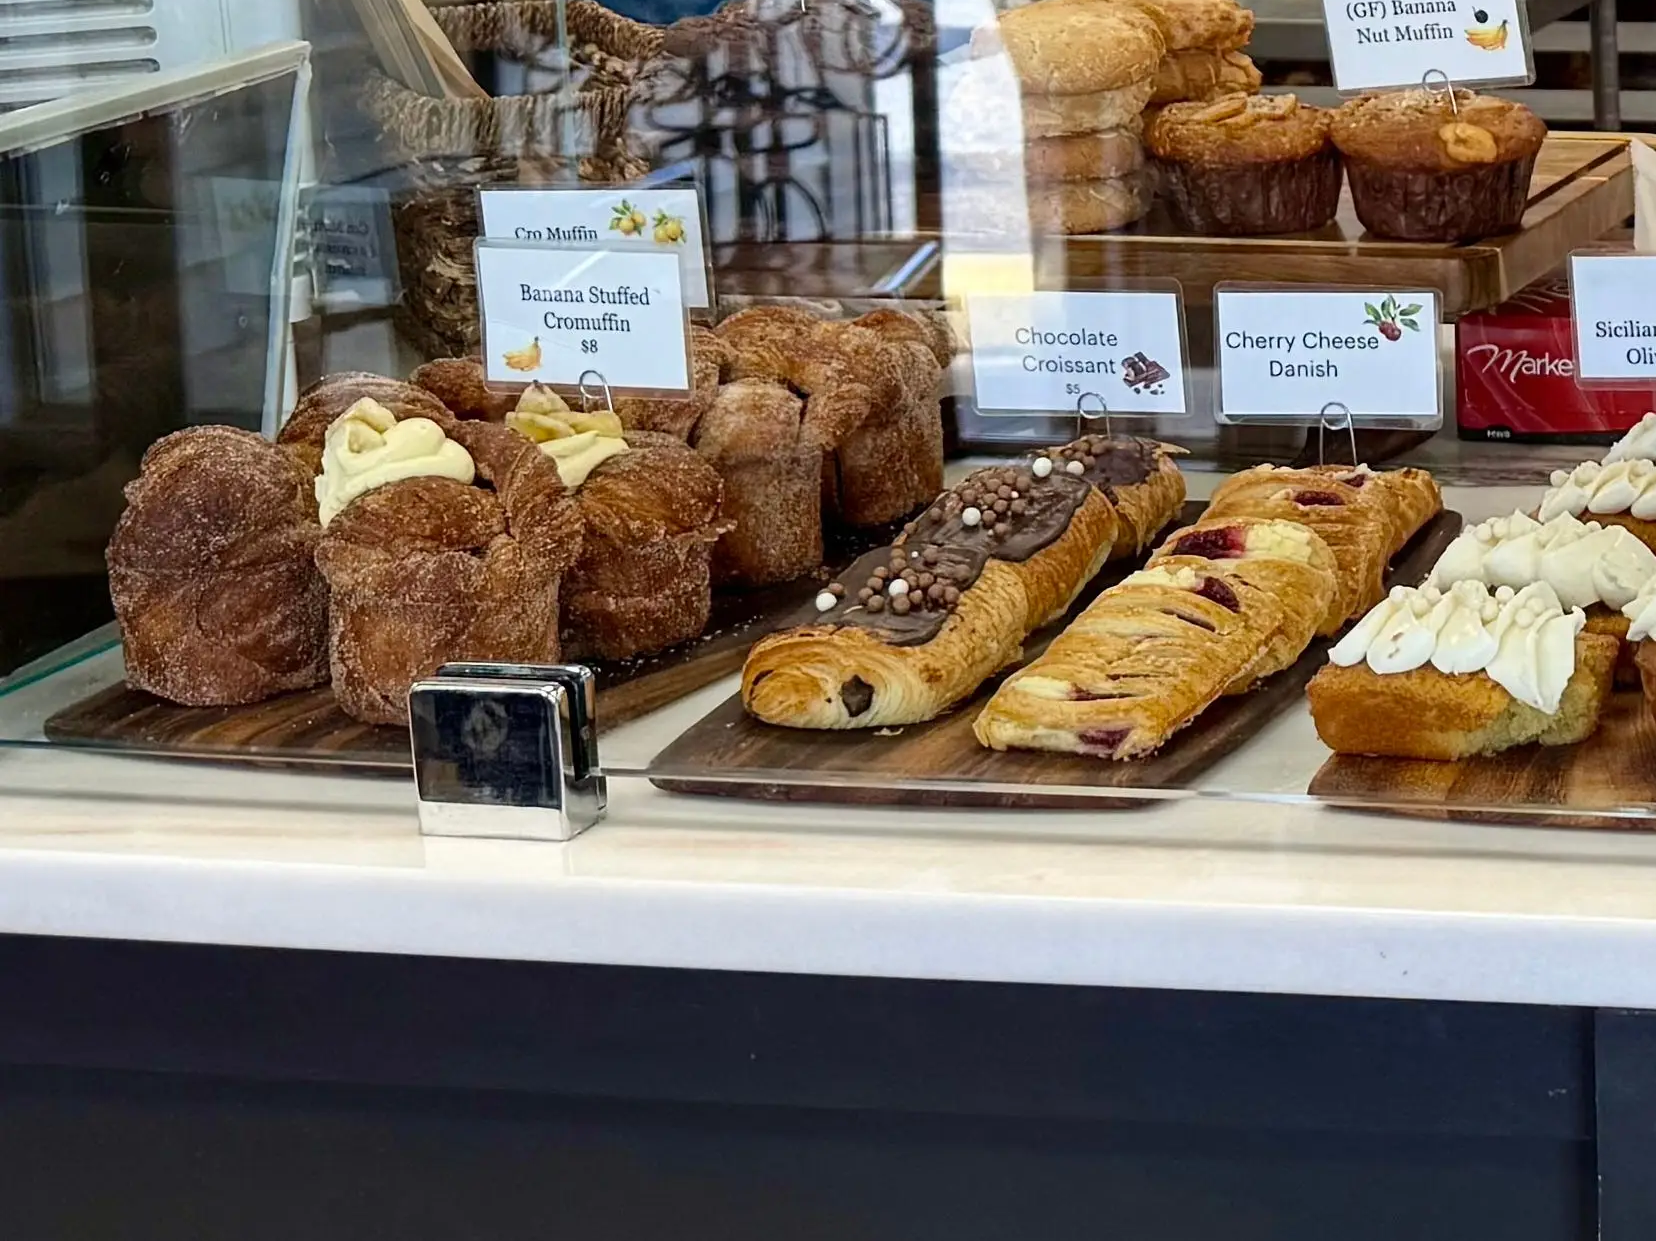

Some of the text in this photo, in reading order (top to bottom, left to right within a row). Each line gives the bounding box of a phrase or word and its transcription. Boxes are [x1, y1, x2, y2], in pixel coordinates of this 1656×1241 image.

[1346, 0, 1457, 21] (GF) Banana
[1357, 23, 1453, 44] Nut Muffin
[514, 225, 598, 242] Cro Muffin
[520, 283, 650, 306] Banana Stuffed
[543, 311, 631, 333] Cromuffin
[581, 338, 598, 354] $8
[1015, 326, 1118, 347] Chocolate
[1225, 331, 1379, 353] Cherry Cheese
[1022, 355, 1116, 374] Croissant
[1269, 359, 1338, 377] Danish
[1467, 343, 1574, 384] Marke
[1065, 383, 1080, 395] $5
